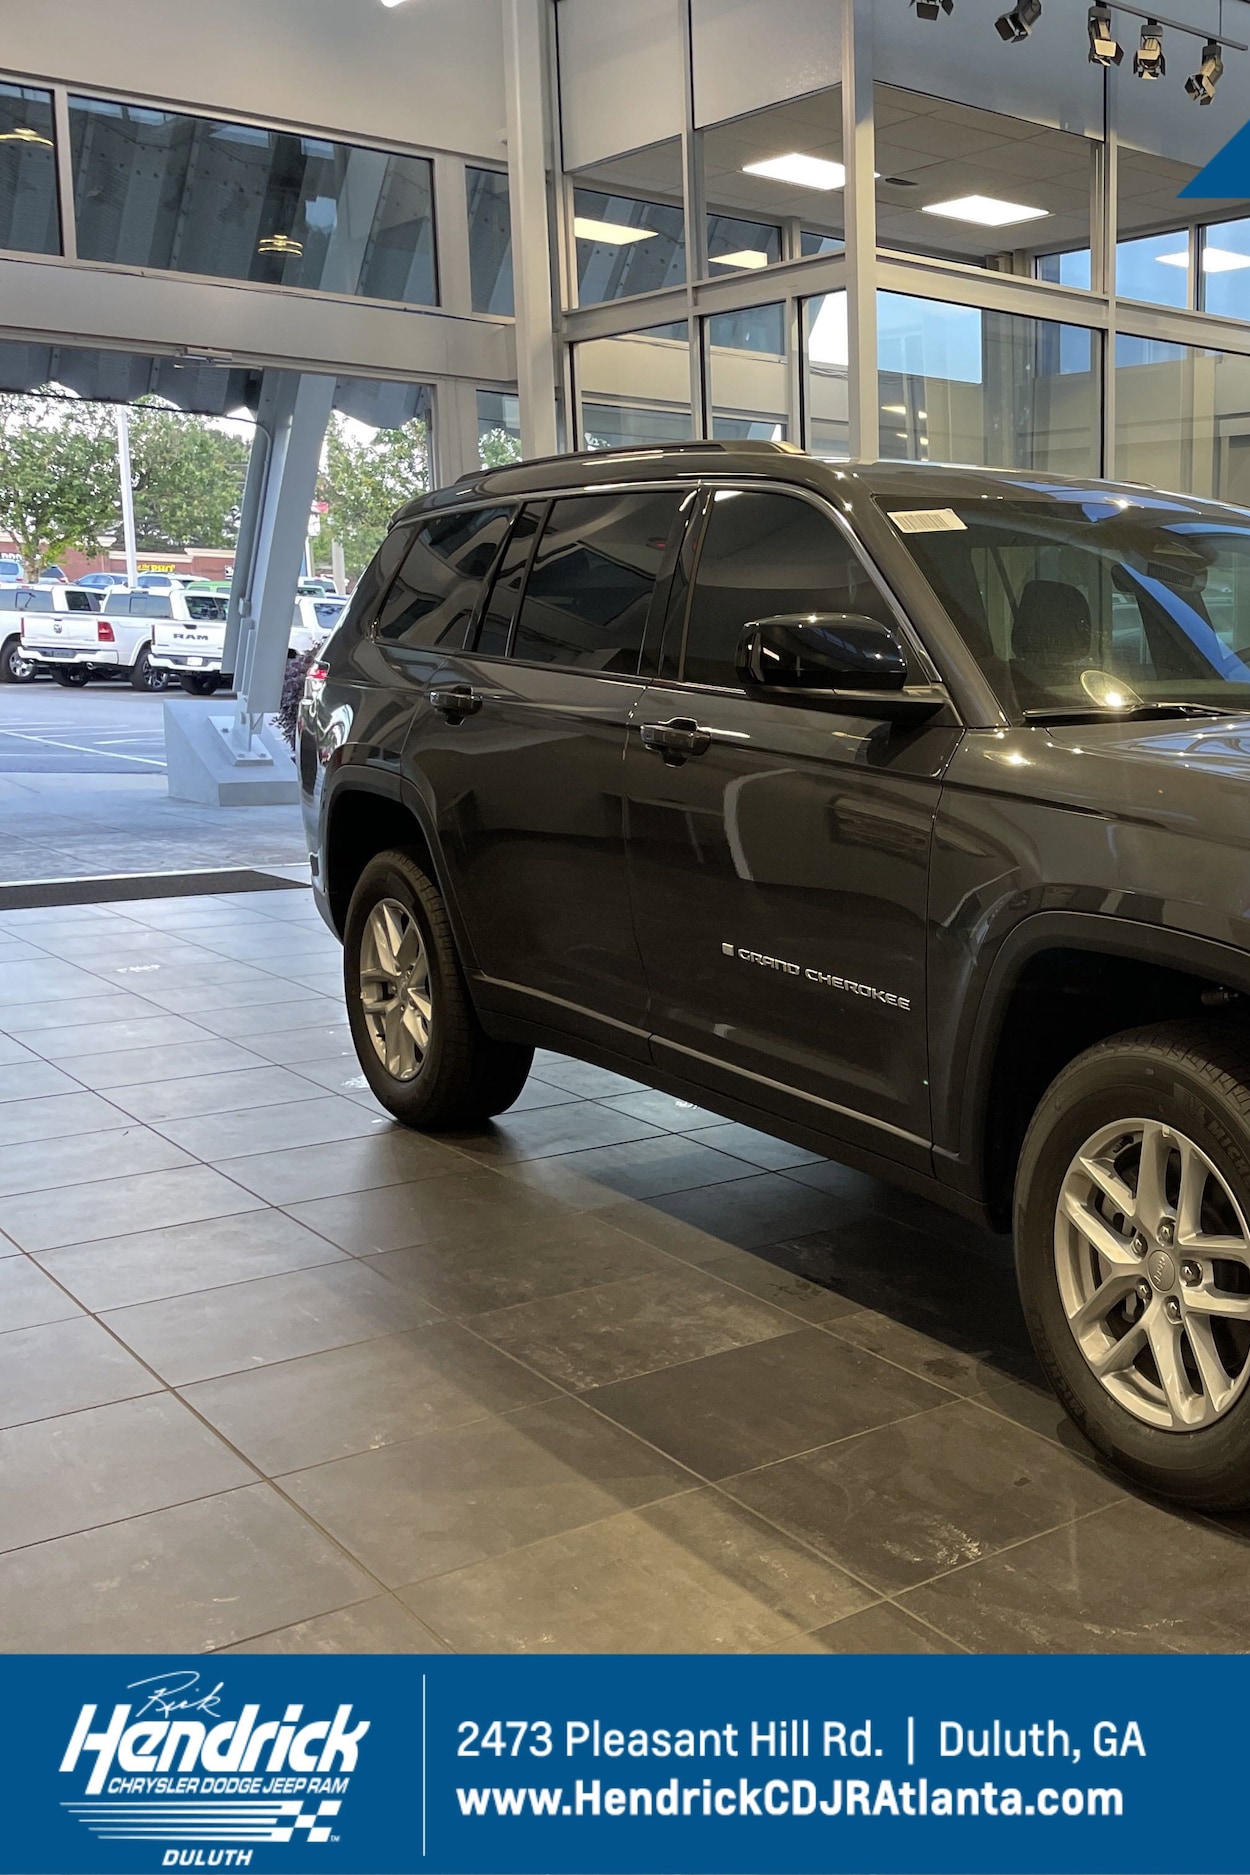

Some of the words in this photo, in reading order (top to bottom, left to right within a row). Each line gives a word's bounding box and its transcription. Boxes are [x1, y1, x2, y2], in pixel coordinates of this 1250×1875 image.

[173, 633, 209, 641] RAM
[737, 947, 801, 977] GRAND
[804, 968, 912, 1012] CHEROKEE
